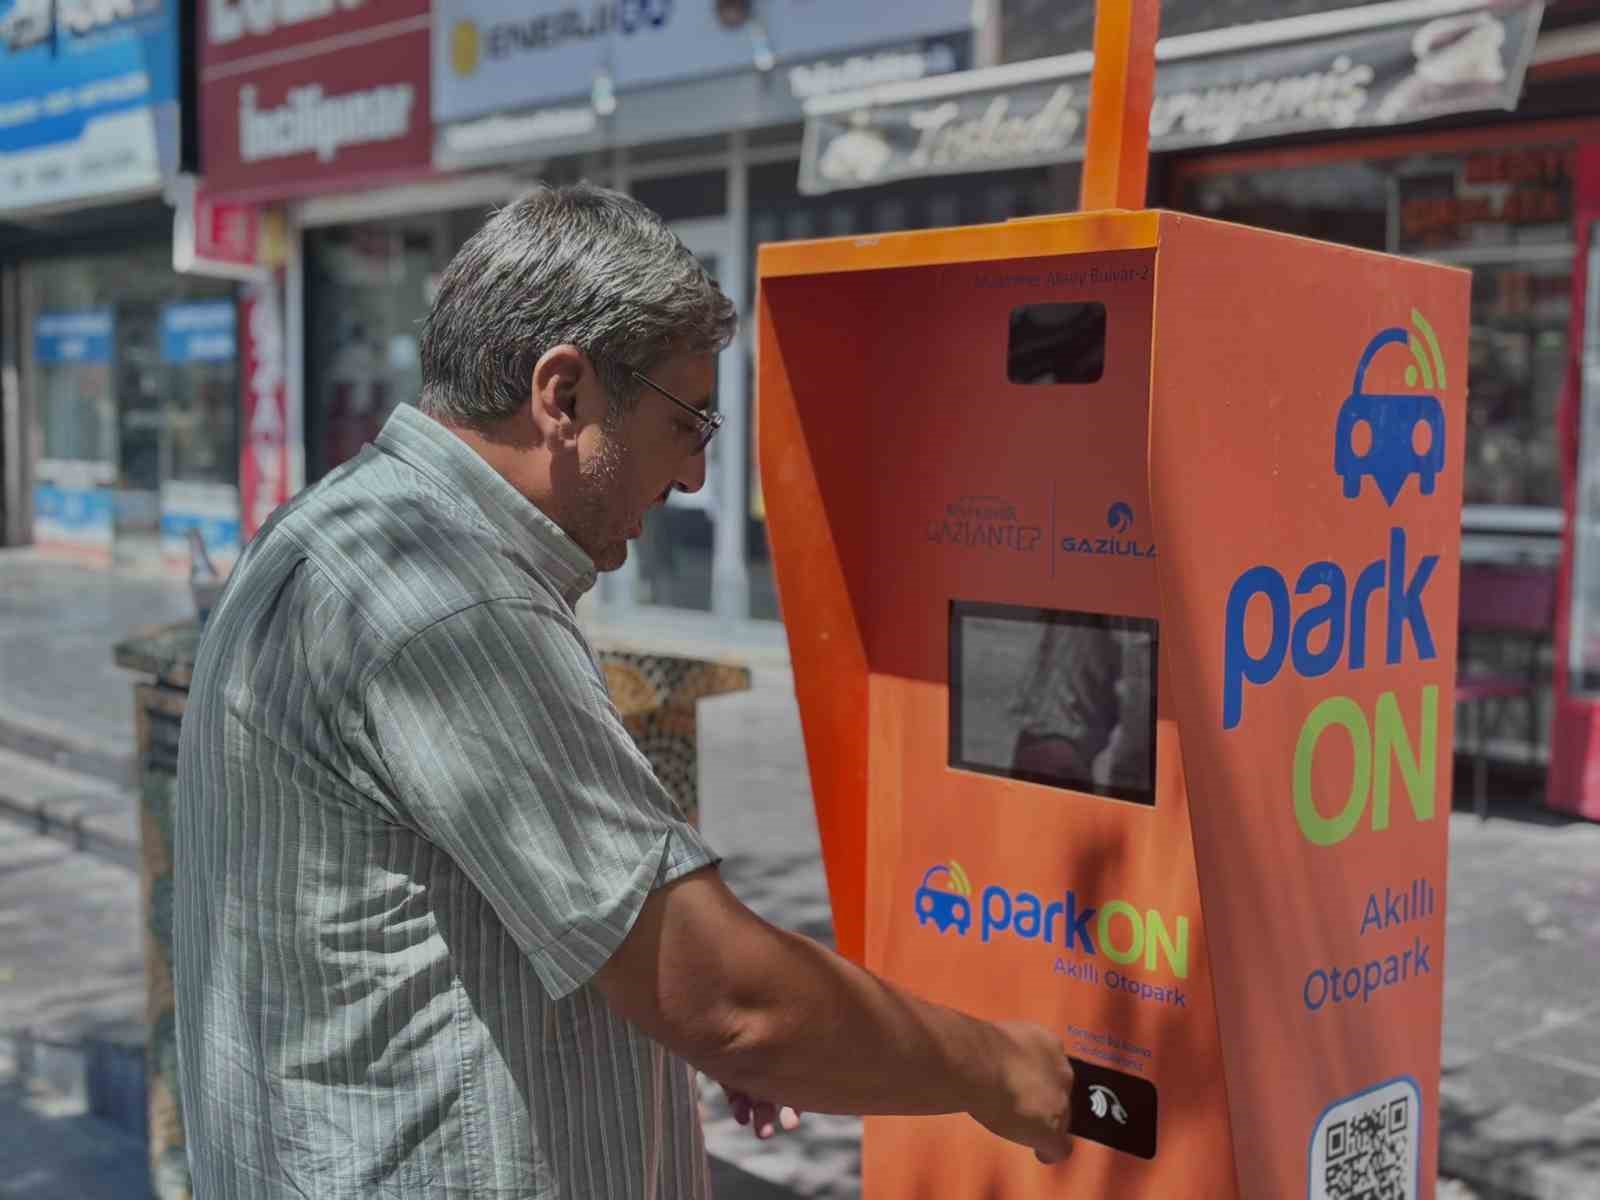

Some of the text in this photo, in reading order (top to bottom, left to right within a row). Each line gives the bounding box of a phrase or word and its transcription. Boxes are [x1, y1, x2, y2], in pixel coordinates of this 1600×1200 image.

[1062, 535, 1157, 559] GAZİULA
[1223, 527, 1440, 730] park
[1293, 685, 1439, 847] ON
[981, 885, 1190, 979] parkON
[1360, 879, 1434, 935] Akıllı
[1103, 970, 1186, 1007] Otopark
[1303, 936, 1431, 1011] Otopark
